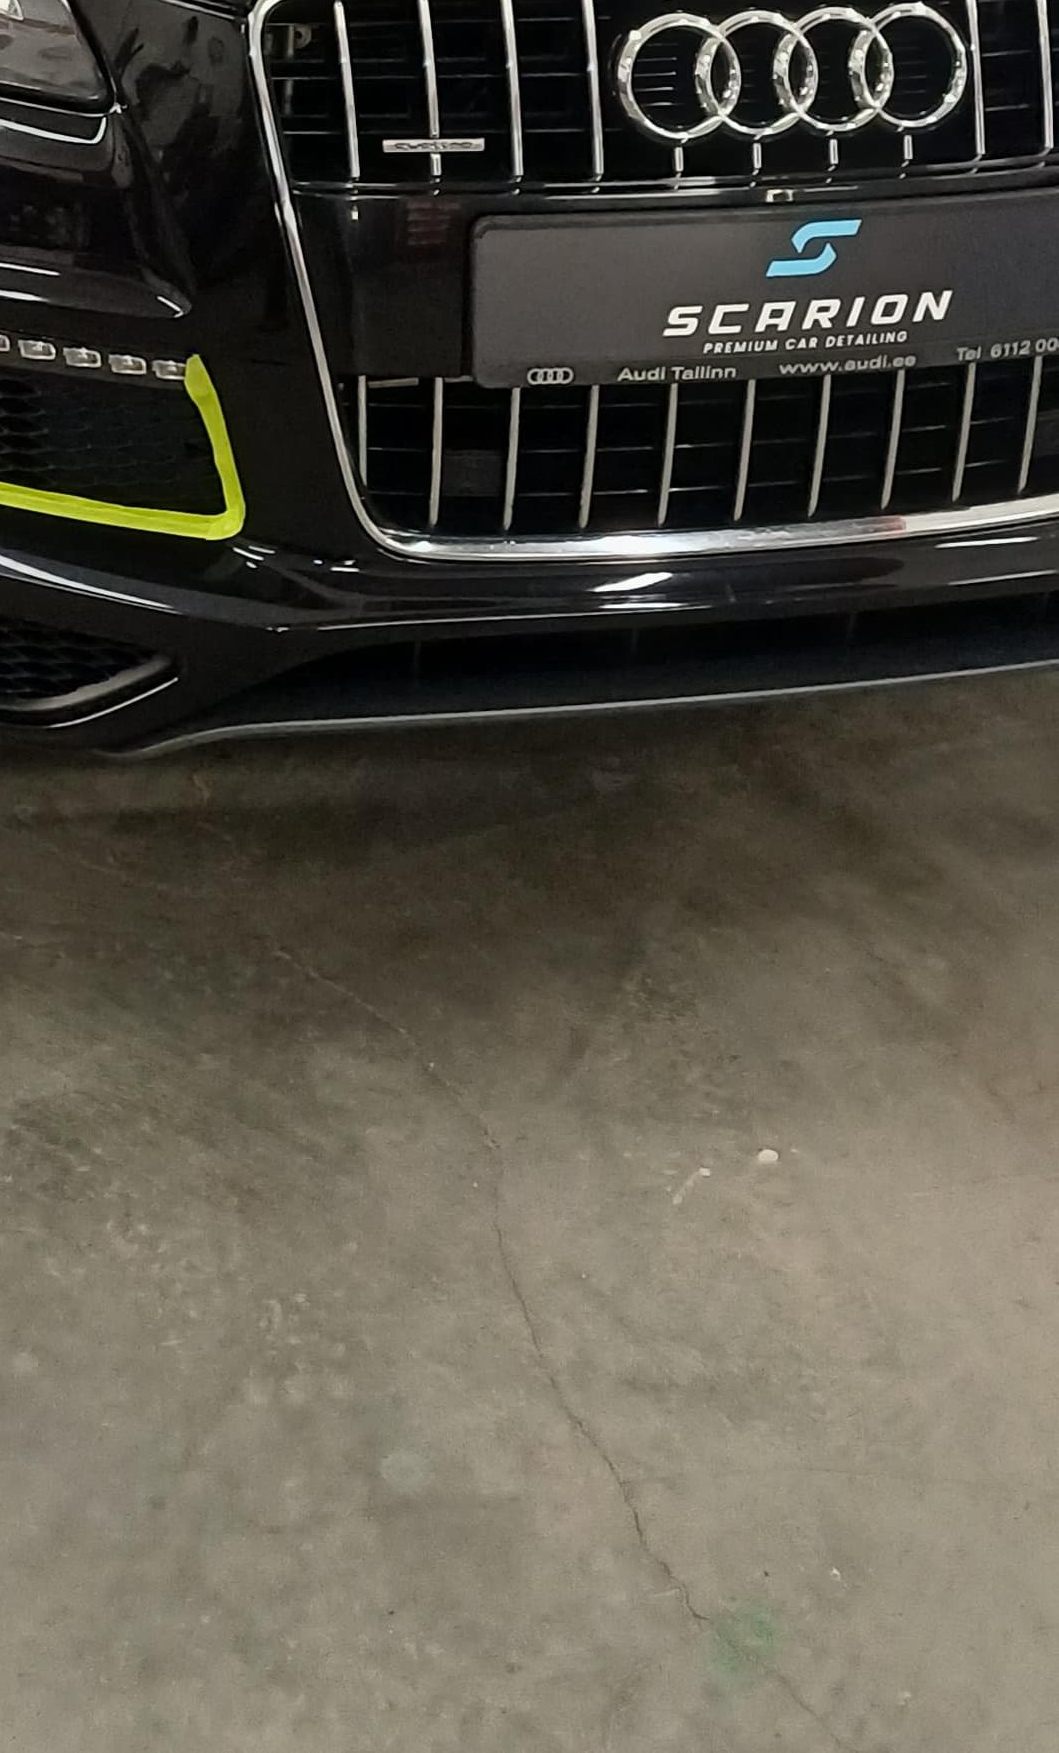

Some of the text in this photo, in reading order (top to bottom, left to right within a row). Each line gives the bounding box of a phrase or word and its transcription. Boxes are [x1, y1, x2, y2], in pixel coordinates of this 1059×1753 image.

[662, 290, 953, 337] SCARION
[617, 368, 665, 382] Audi
[670, 366, 737, 381] Tallinn
[956, 345, 982, 362] Tel
[990, 339, 1031, 359] 6112
[1035, 336, 1059, 353] 00
[703, 331, 908, 354] PREMIUM CAR DETAILING
